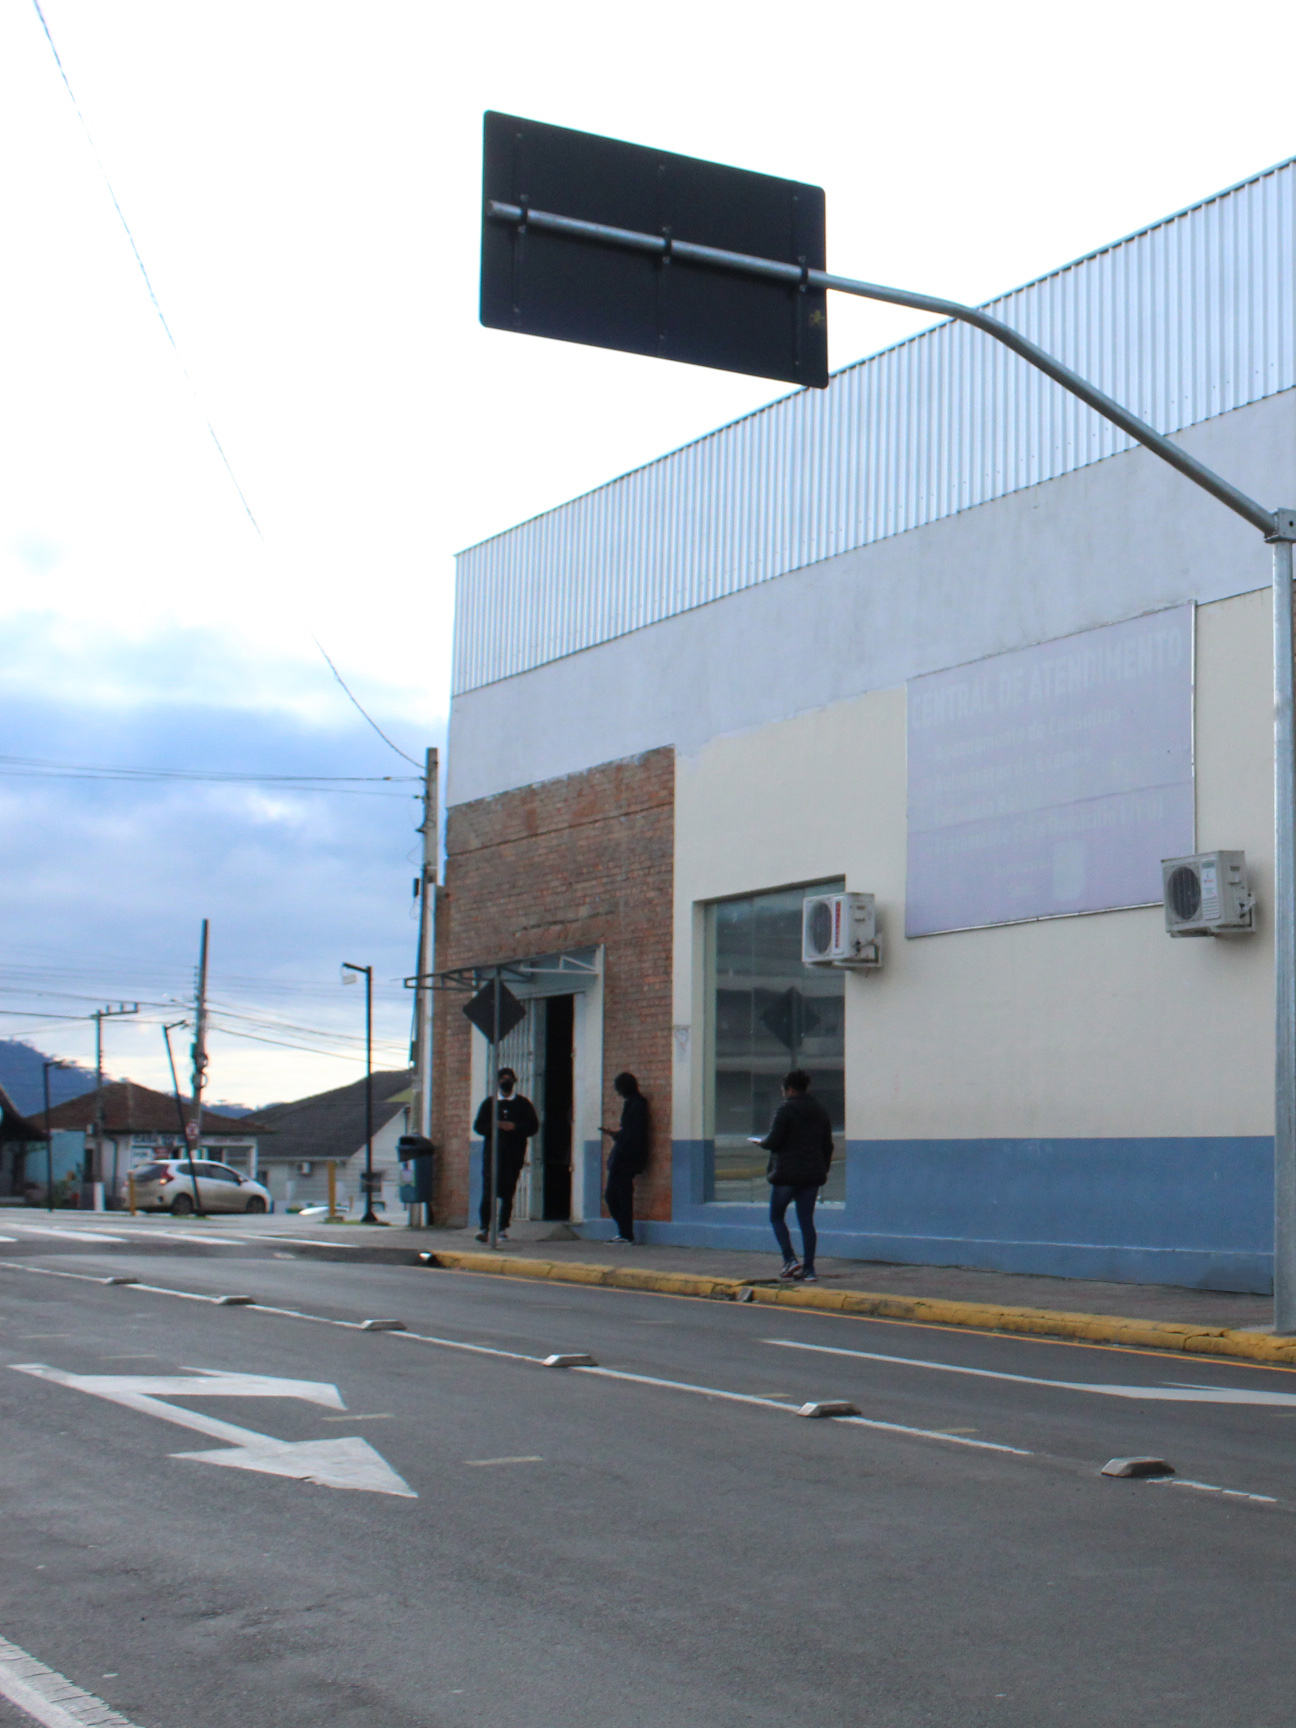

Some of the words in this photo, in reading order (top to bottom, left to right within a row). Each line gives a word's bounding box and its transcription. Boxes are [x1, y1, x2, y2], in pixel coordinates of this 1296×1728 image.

[911, 679, 994, 730] CENTRAL
[999, 668, 1025, 708] DE
[1028, 627, 1182, 702] ATENDIMENTO
